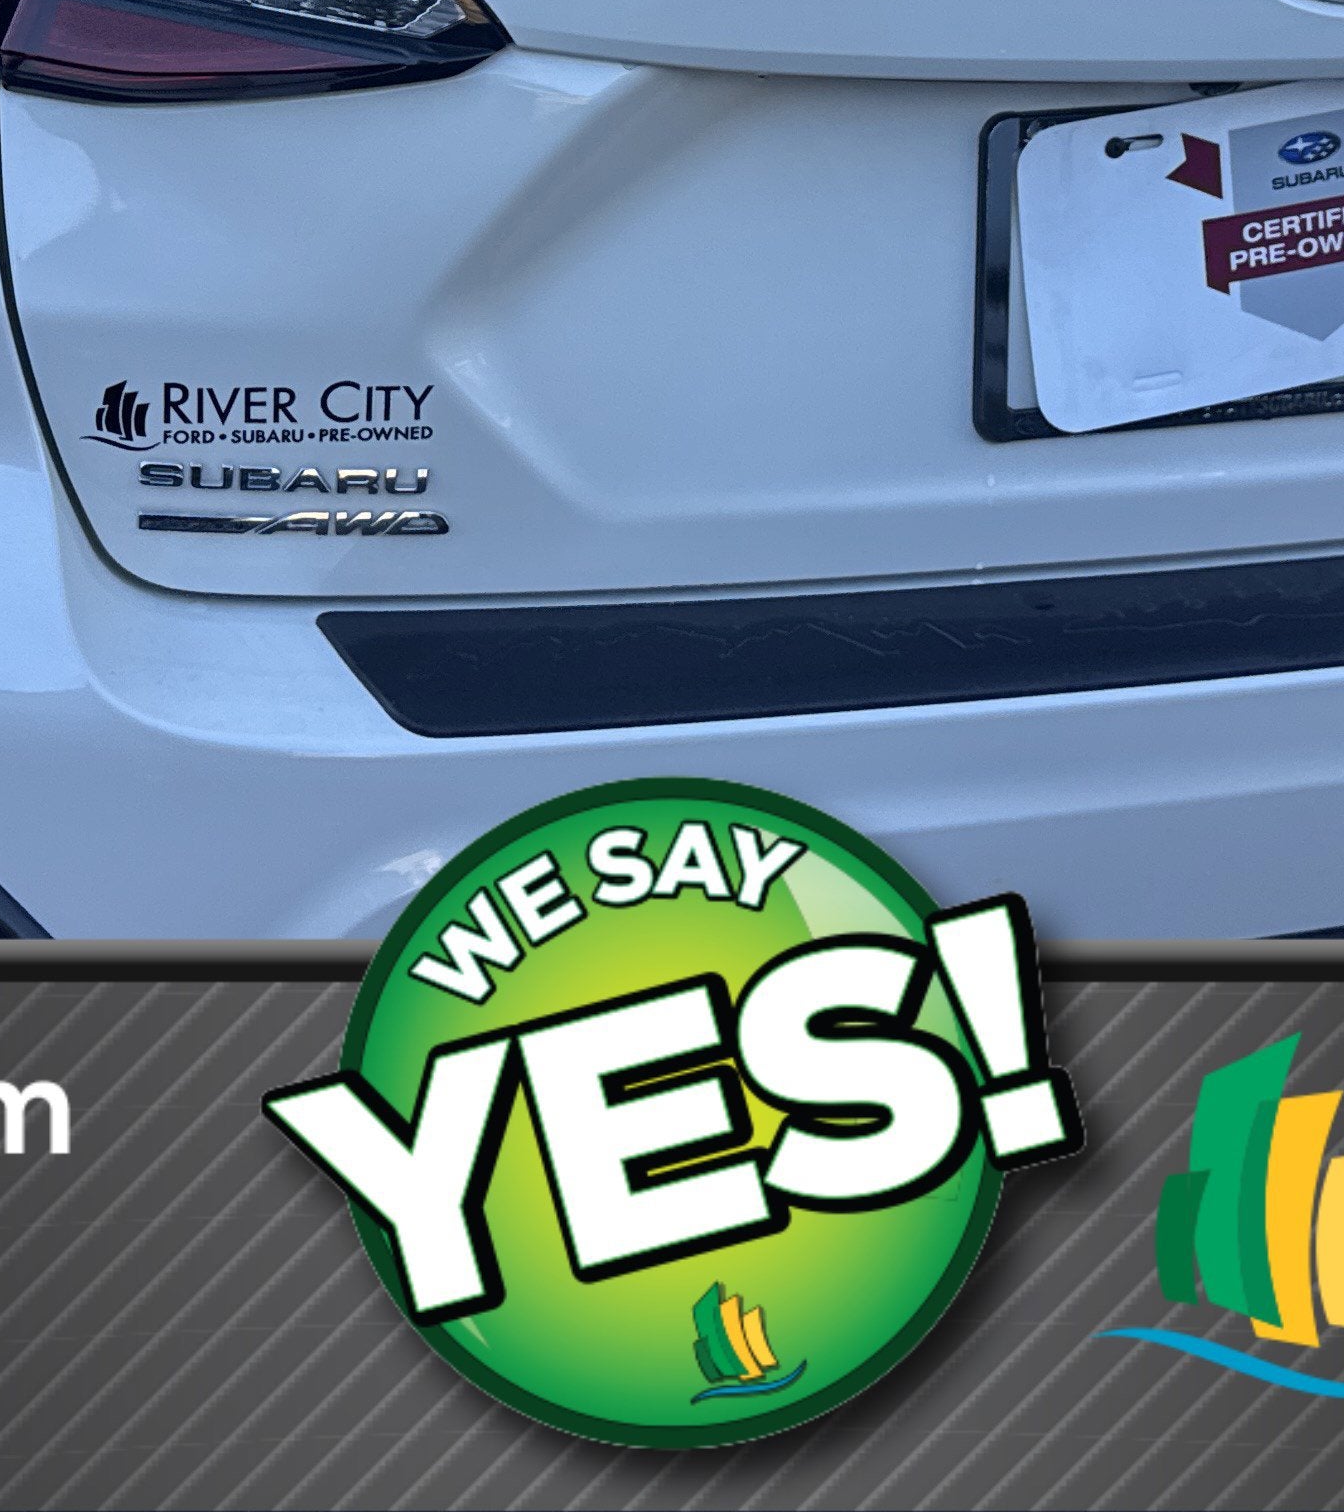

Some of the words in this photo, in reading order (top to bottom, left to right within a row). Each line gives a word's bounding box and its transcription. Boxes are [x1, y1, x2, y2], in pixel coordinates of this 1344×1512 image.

[163, 382, 298, 426] RIVER
[320, 380, 435, 423] CITY
[162, 429, 215, 445] FORD
[230, 428, 304, 444] SUBARU
[318, 425, 434, 443] PRE-OWNED
[138, 460, 430, 495] SUBARU
[255, 510, 450, 537] AWD
